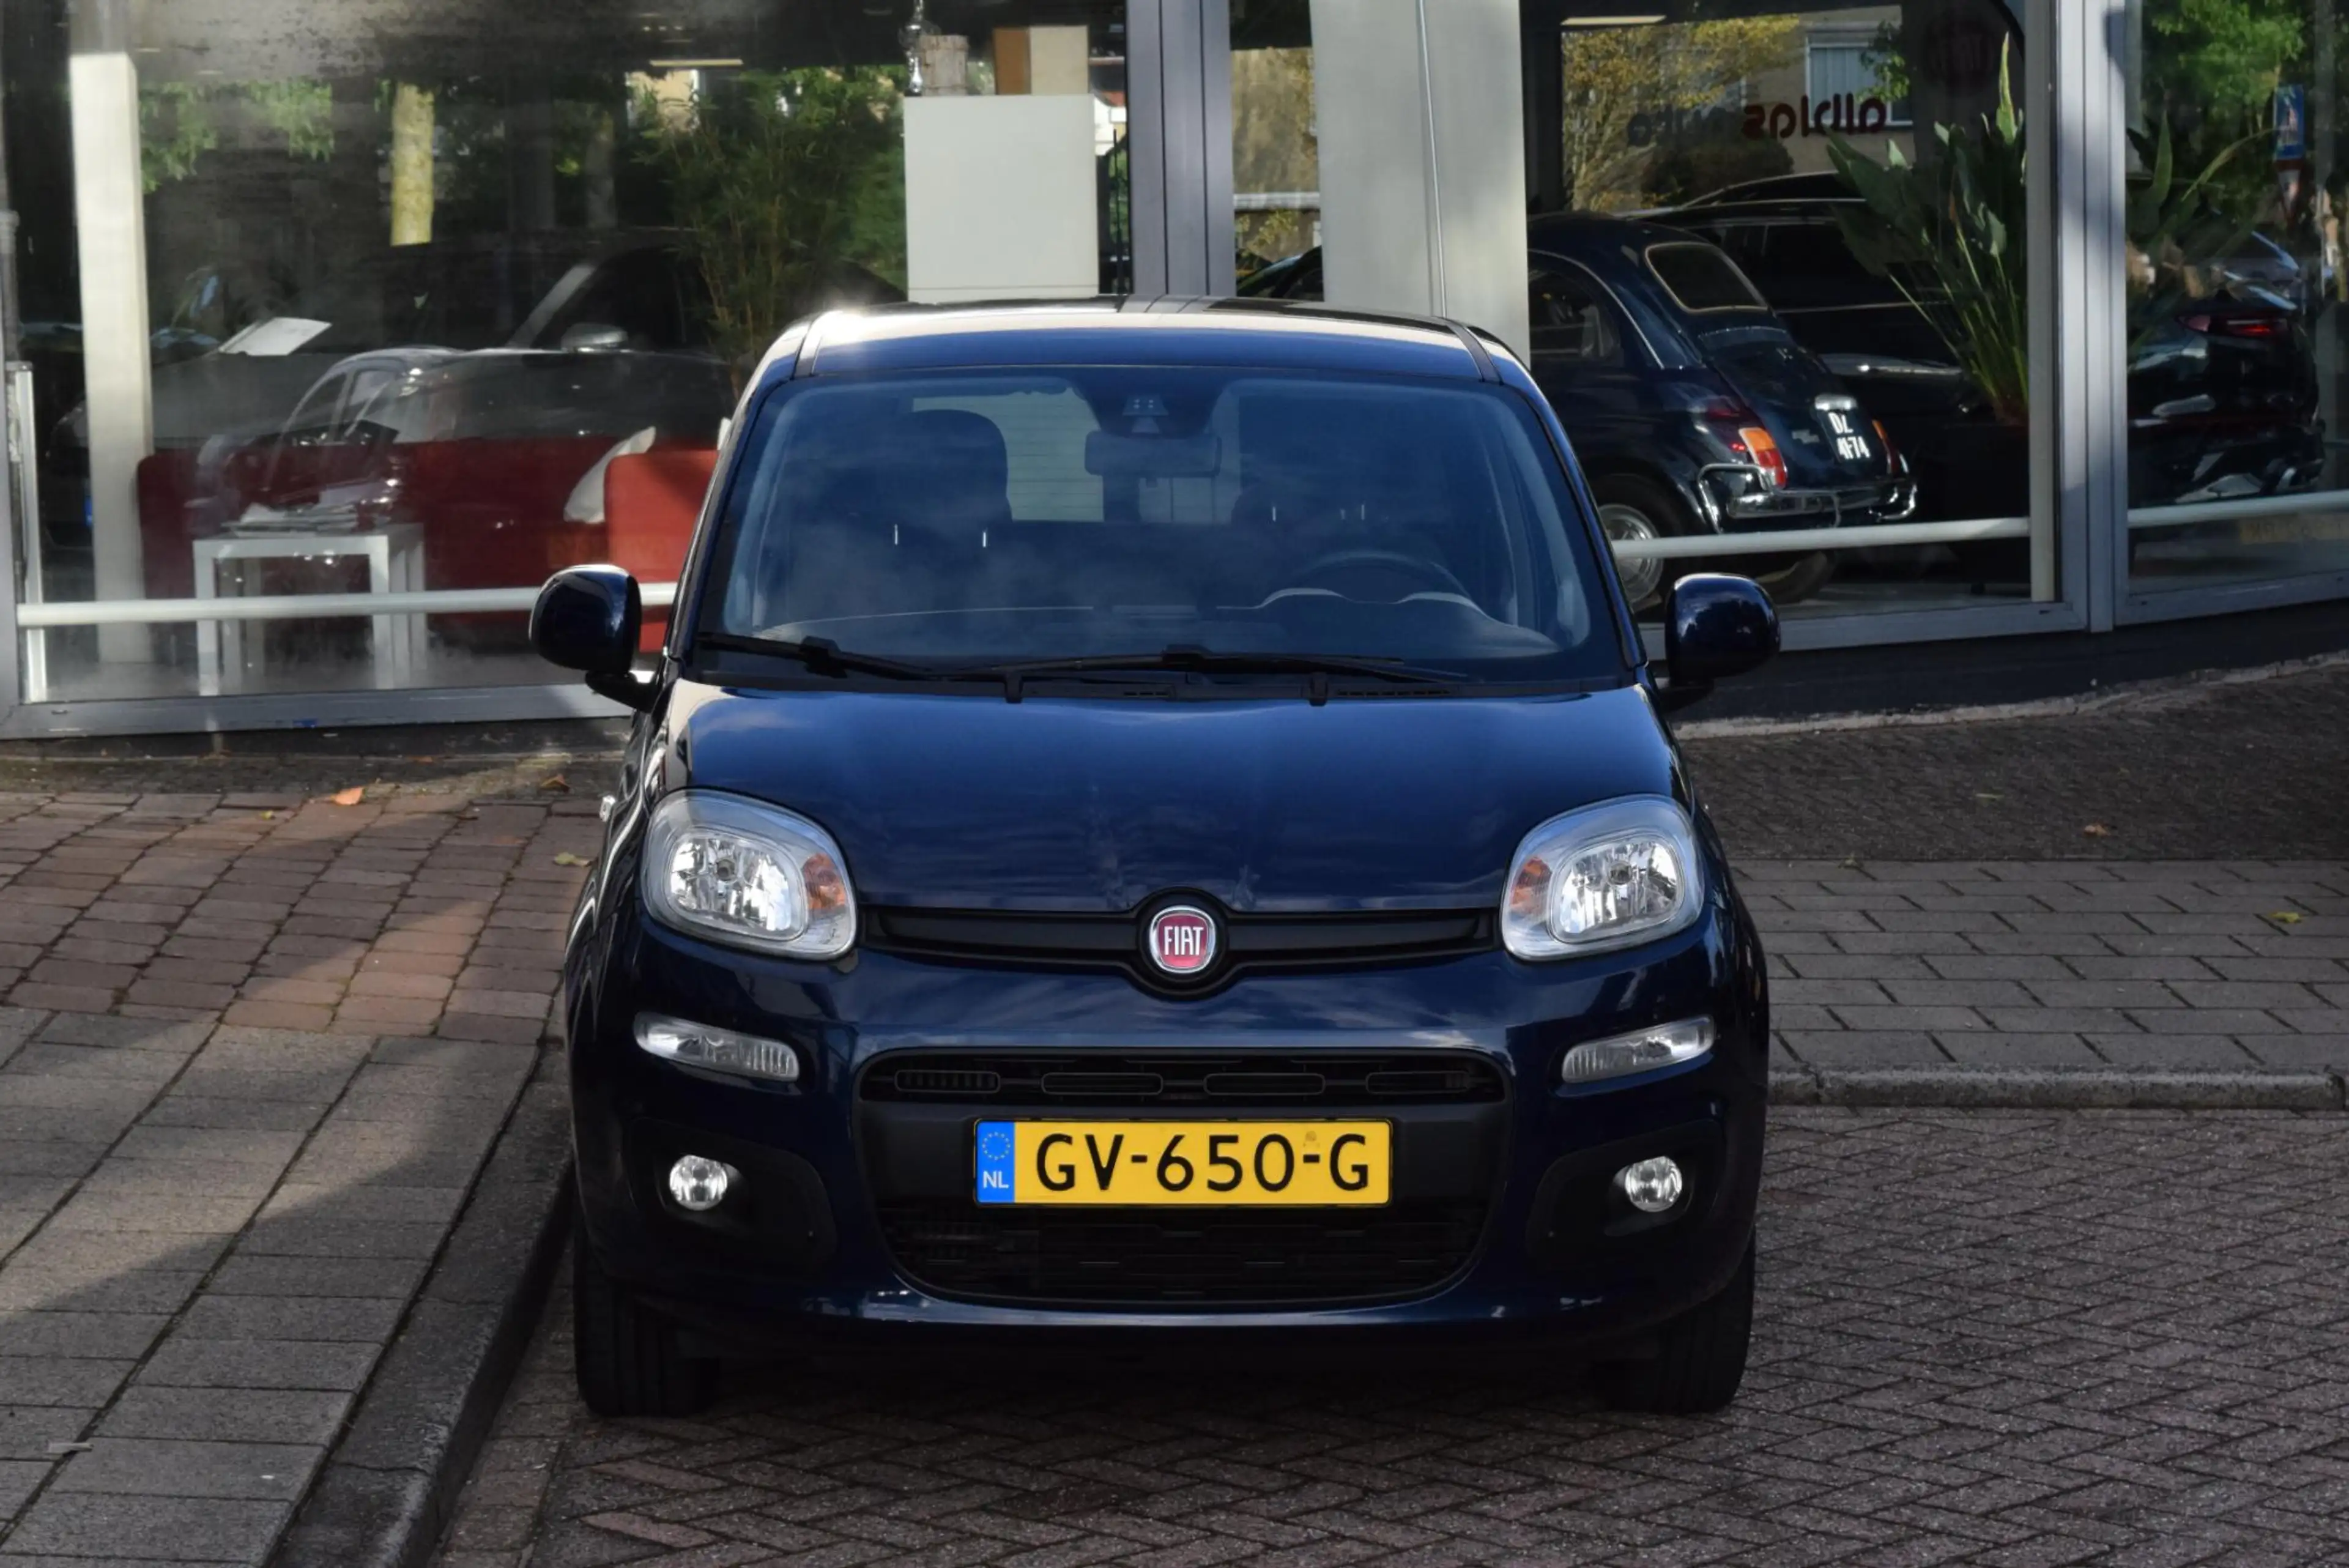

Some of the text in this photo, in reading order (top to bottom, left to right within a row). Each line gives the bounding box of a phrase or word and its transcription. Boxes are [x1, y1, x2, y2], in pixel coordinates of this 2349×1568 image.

[1164, 926, 1204, 956] FIAT
[982, 1133, 1369, 1192] NL GV-650-G
